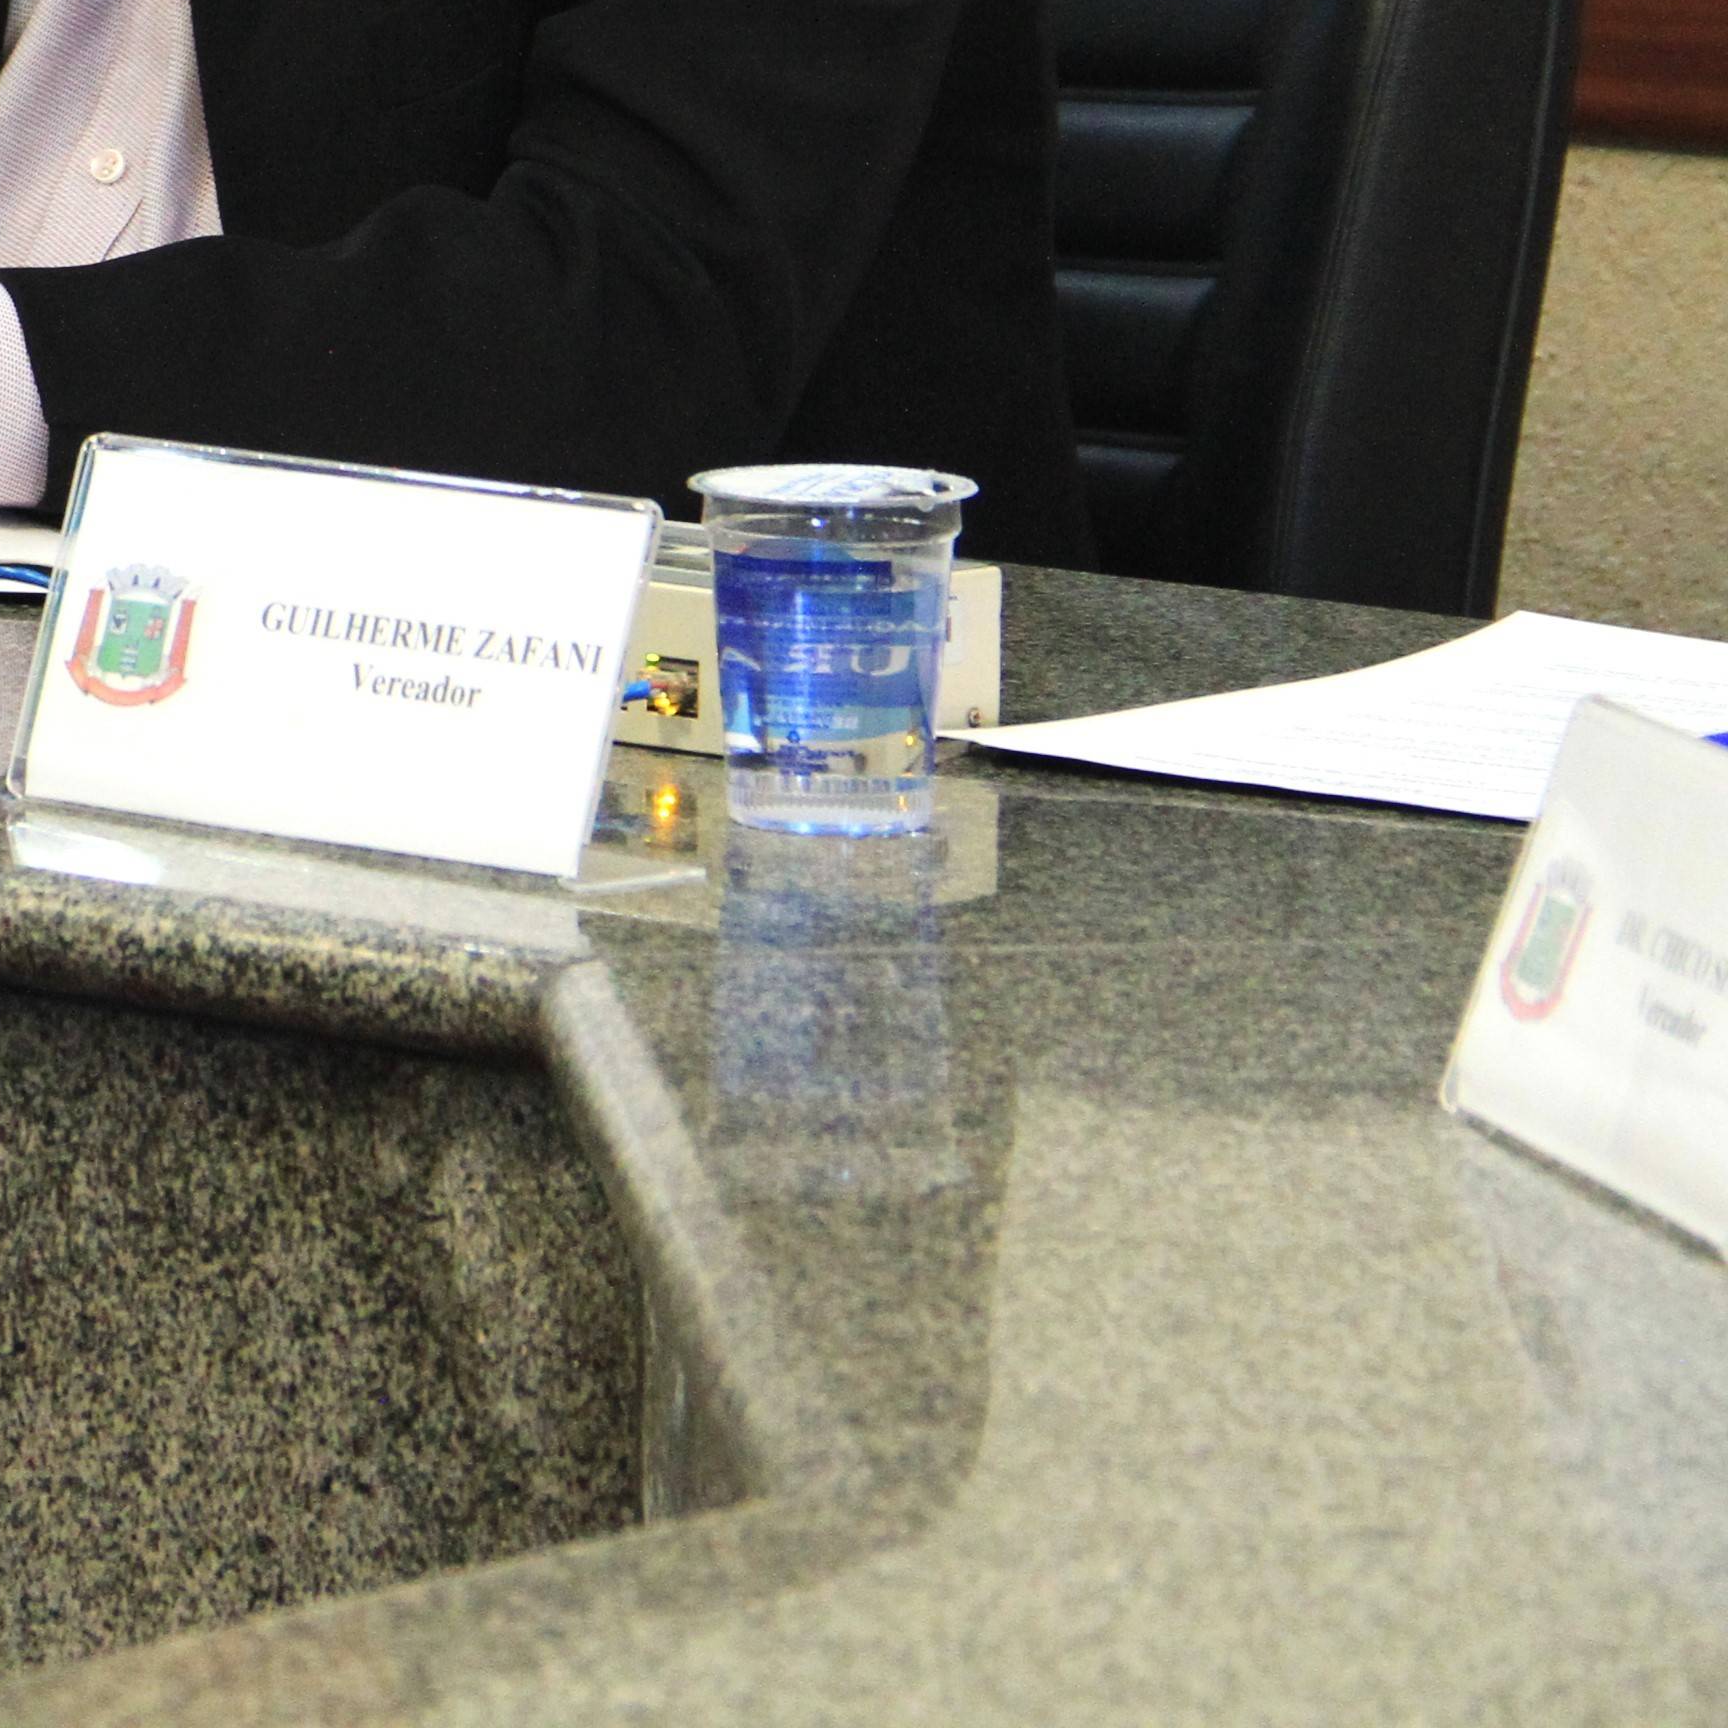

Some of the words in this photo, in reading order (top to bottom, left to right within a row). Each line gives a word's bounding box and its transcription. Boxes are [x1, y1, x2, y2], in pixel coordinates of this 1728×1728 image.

[261, 600, 467, 658] GUILHERME
[473, 628, 605, 676] ZAFANI
[352, 662, 483, 709] Vereador
